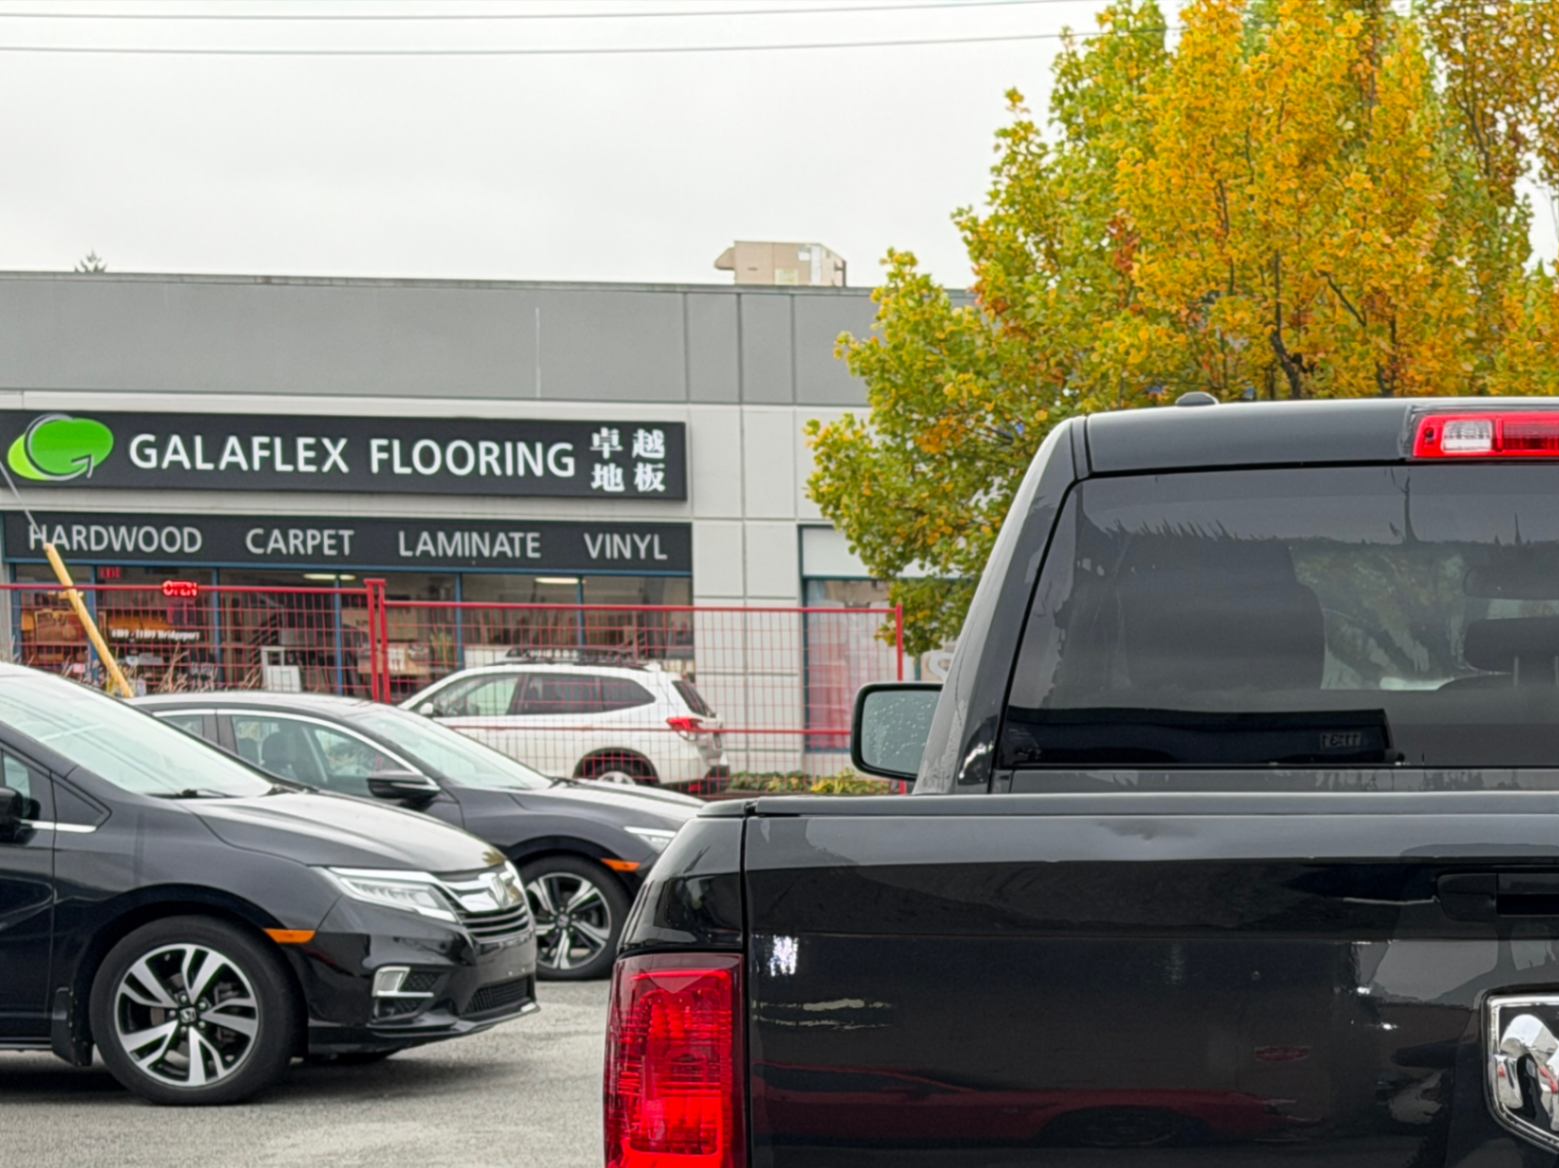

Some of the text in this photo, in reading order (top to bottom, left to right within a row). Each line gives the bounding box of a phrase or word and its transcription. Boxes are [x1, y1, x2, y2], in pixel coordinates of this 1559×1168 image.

[128, 433, 576, 478] GALAFLEX FLOORING
[589, 426, 666, 460] 卓越
[590, 461, 667, 493] 地板
[28, 524, 203, 553] HARDWOOD
[245, 528, 355, 557] CARPET
[398, 530, 542, 558] LAMINATE
[583, 532, 669, 561] VINYL
